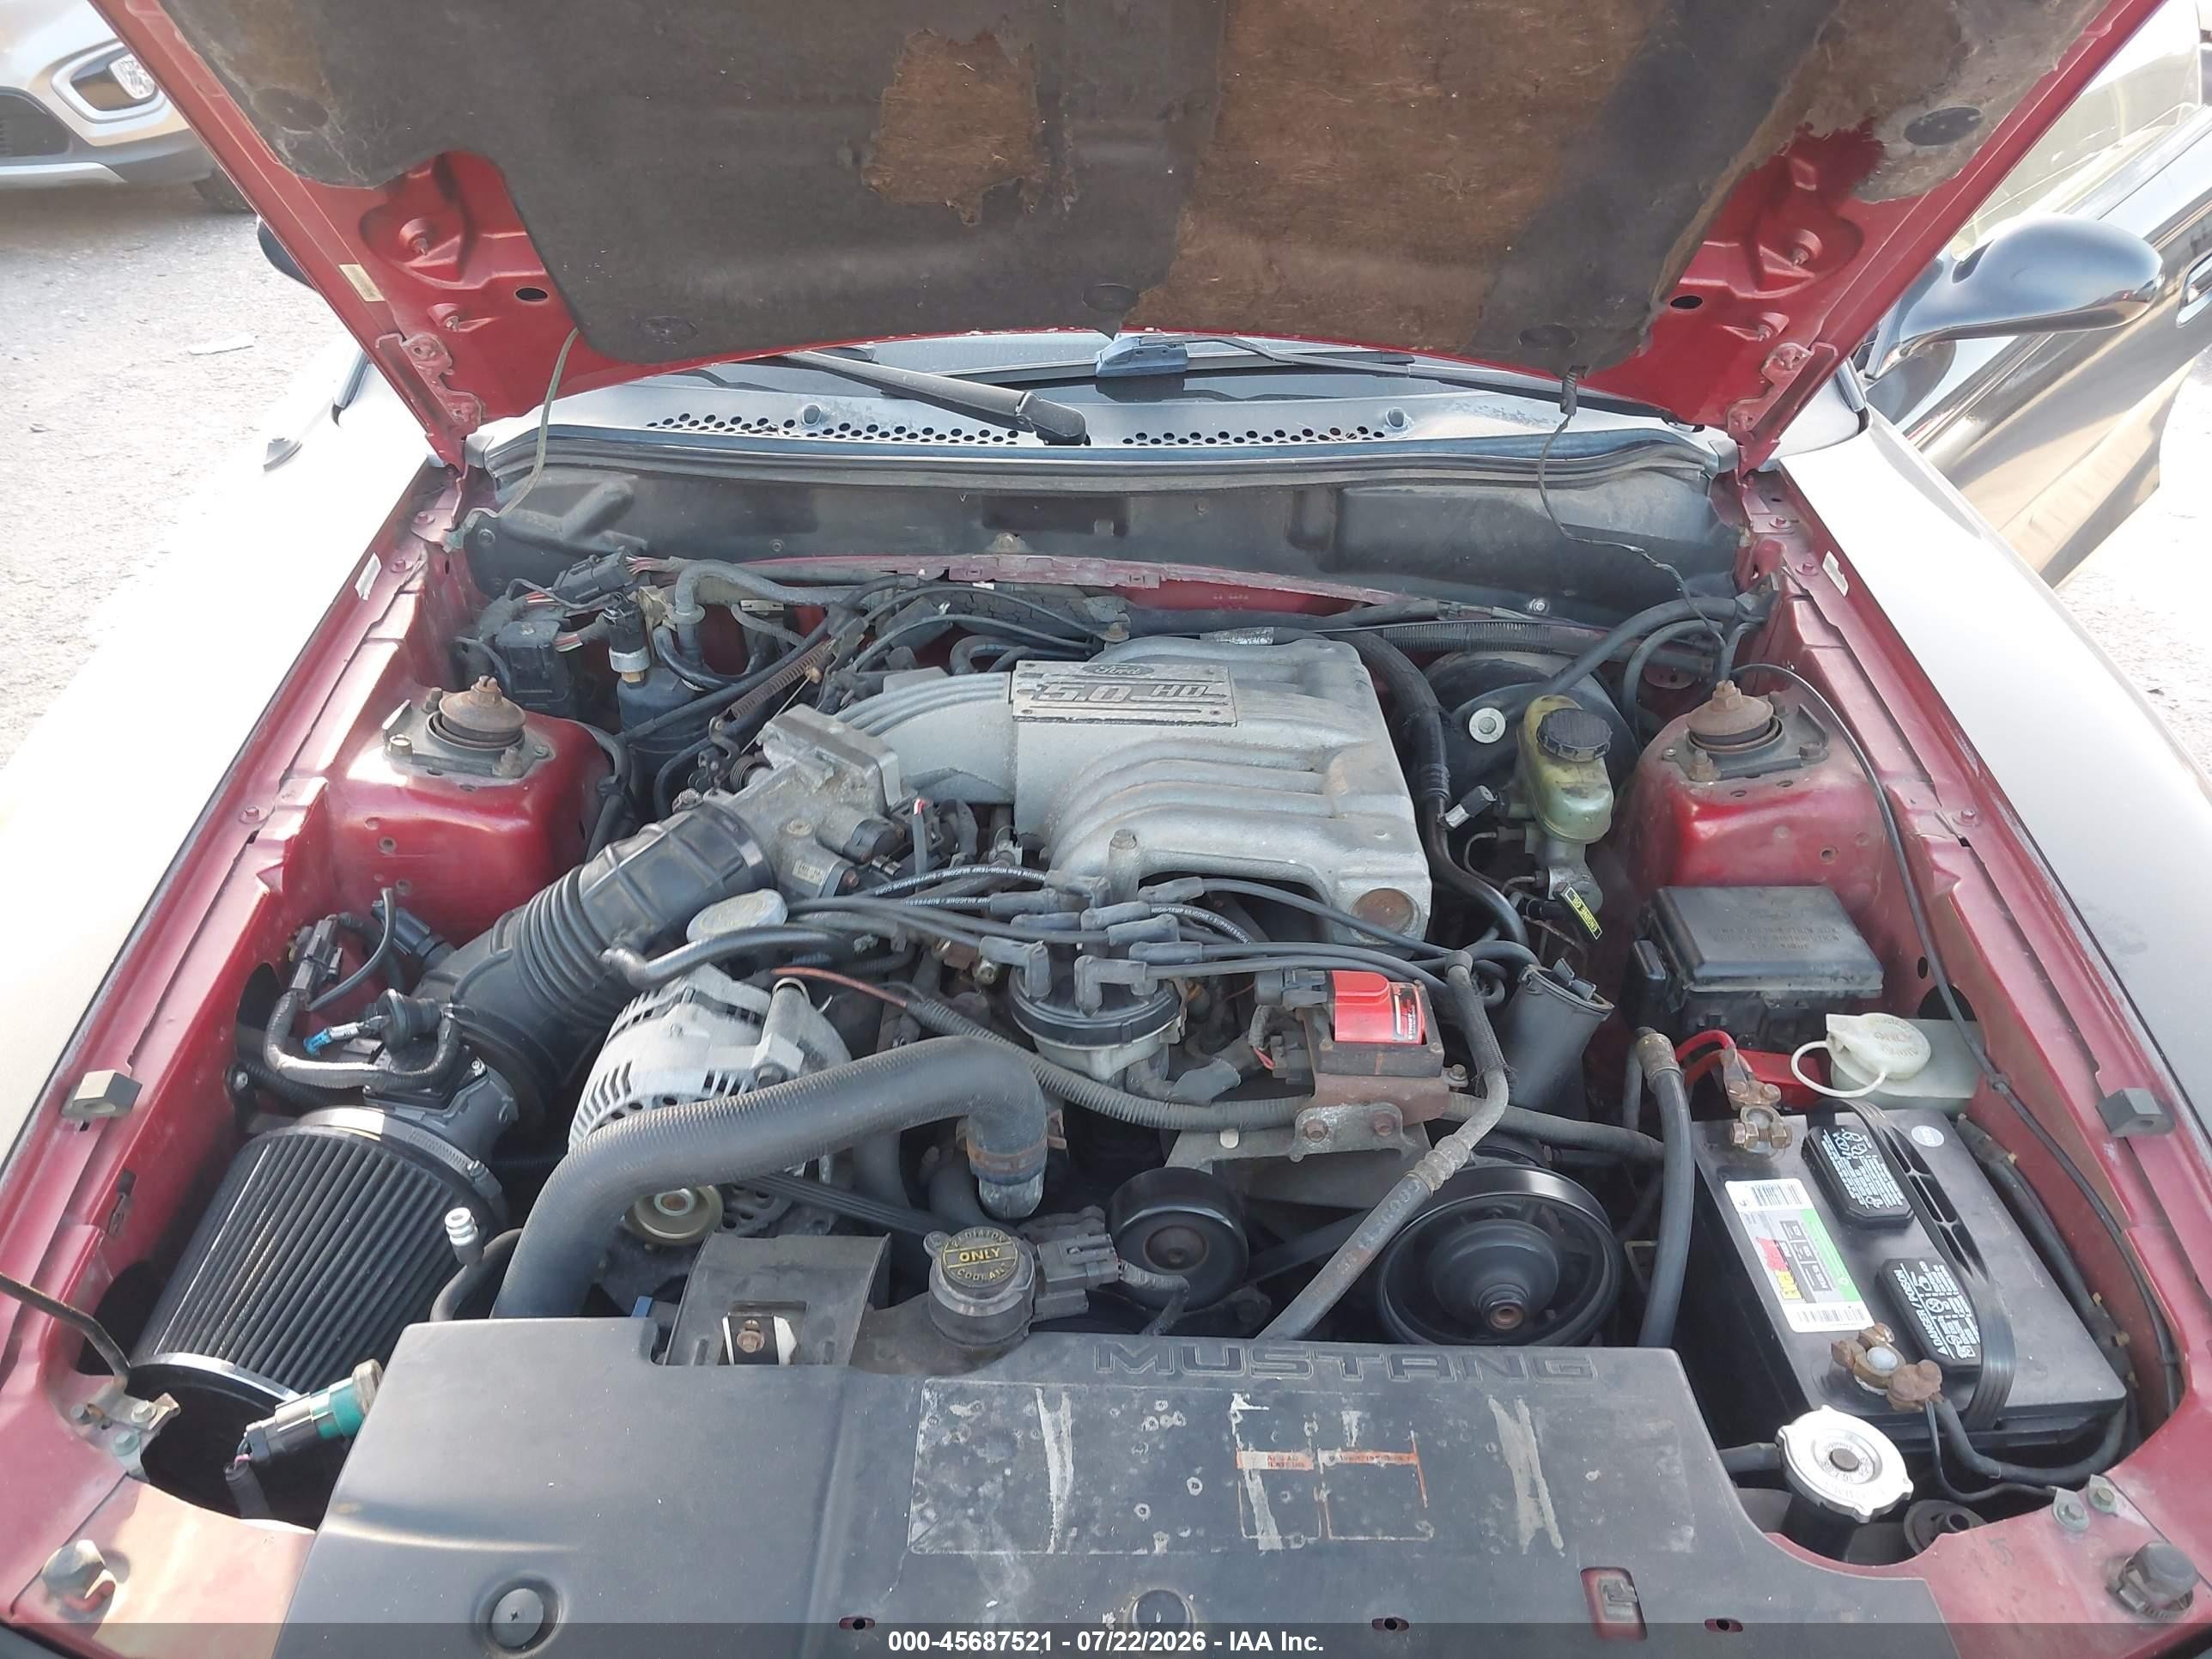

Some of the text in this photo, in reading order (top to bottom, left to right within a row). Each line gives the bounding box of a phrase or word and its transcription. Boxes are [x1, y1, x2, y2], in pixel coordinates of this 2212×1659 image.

[1094, 665, 1143, 676] Ford
[1038, 684, 1133, 702] 5.0
[1572, 894, 1597, 933] ENGINE OIL
[959, 1248, 1001, 1262] ONLY
[1893, 1269, 1919, 1302] POISON
[1916, 1310, 1943, 1346] DANGER
[1093, 1343, 1599, 1382] MUSTANG
